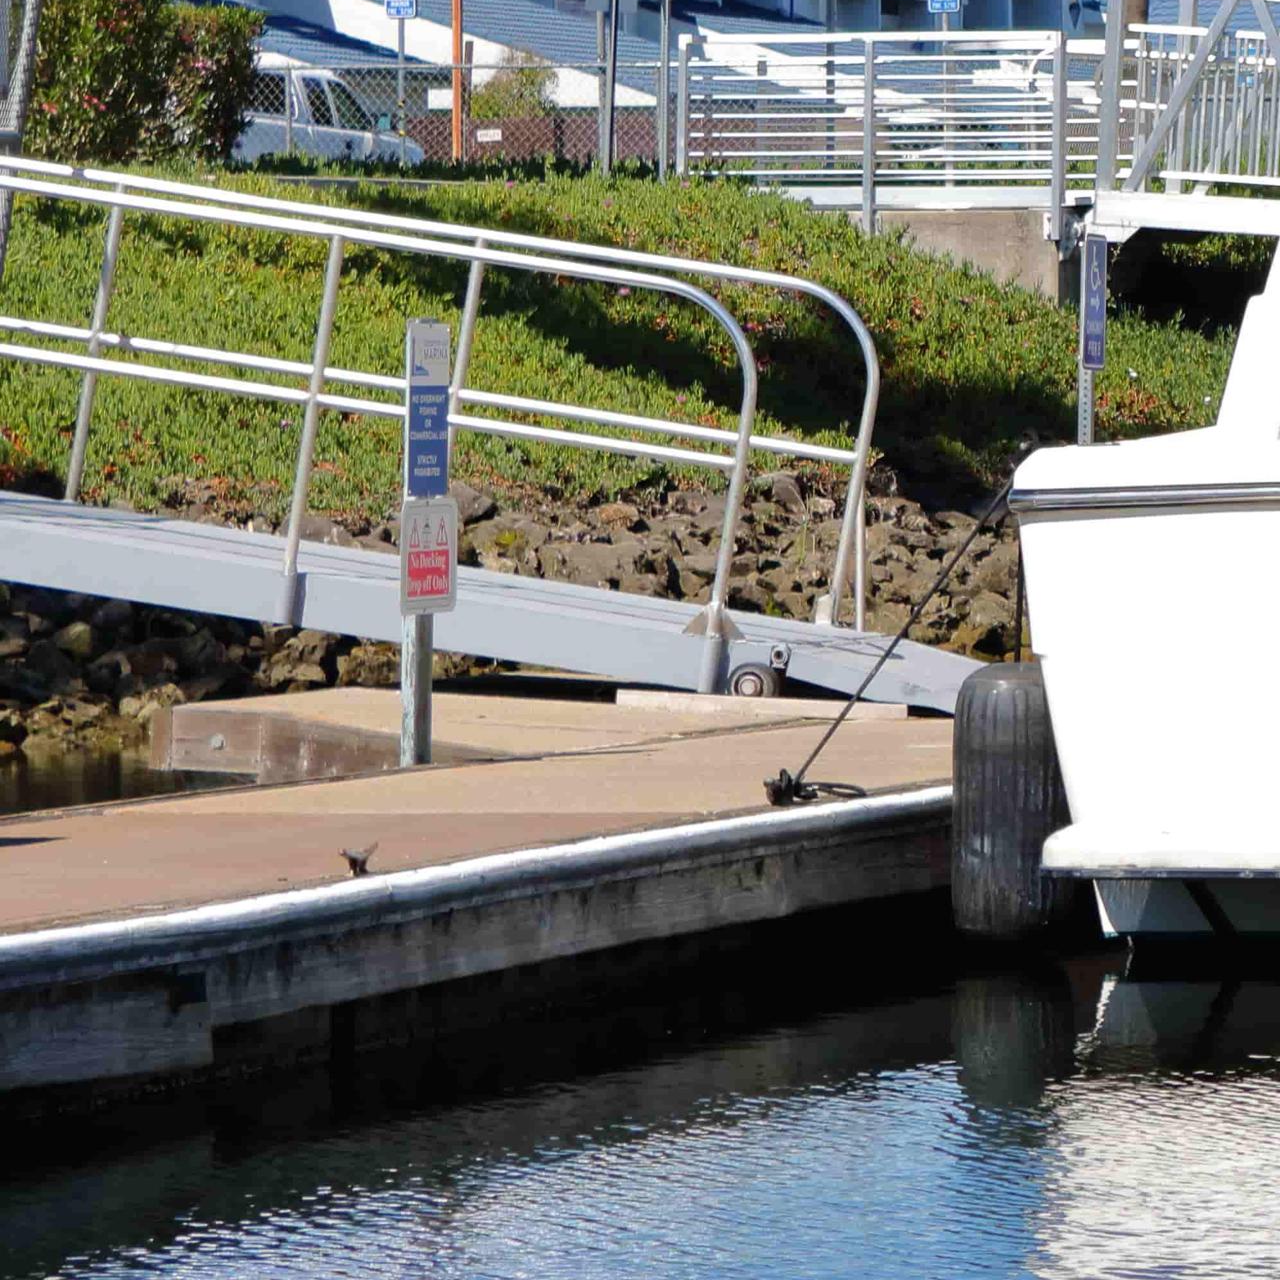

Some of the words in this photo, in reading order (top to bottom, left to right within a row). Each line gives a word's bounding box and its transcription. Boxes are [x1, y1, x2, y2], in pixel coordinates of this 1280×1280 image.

[411, 553, 419, 569] No
[420, 552, 447, 570] Docking
[432, 575, 448, 593] Only
